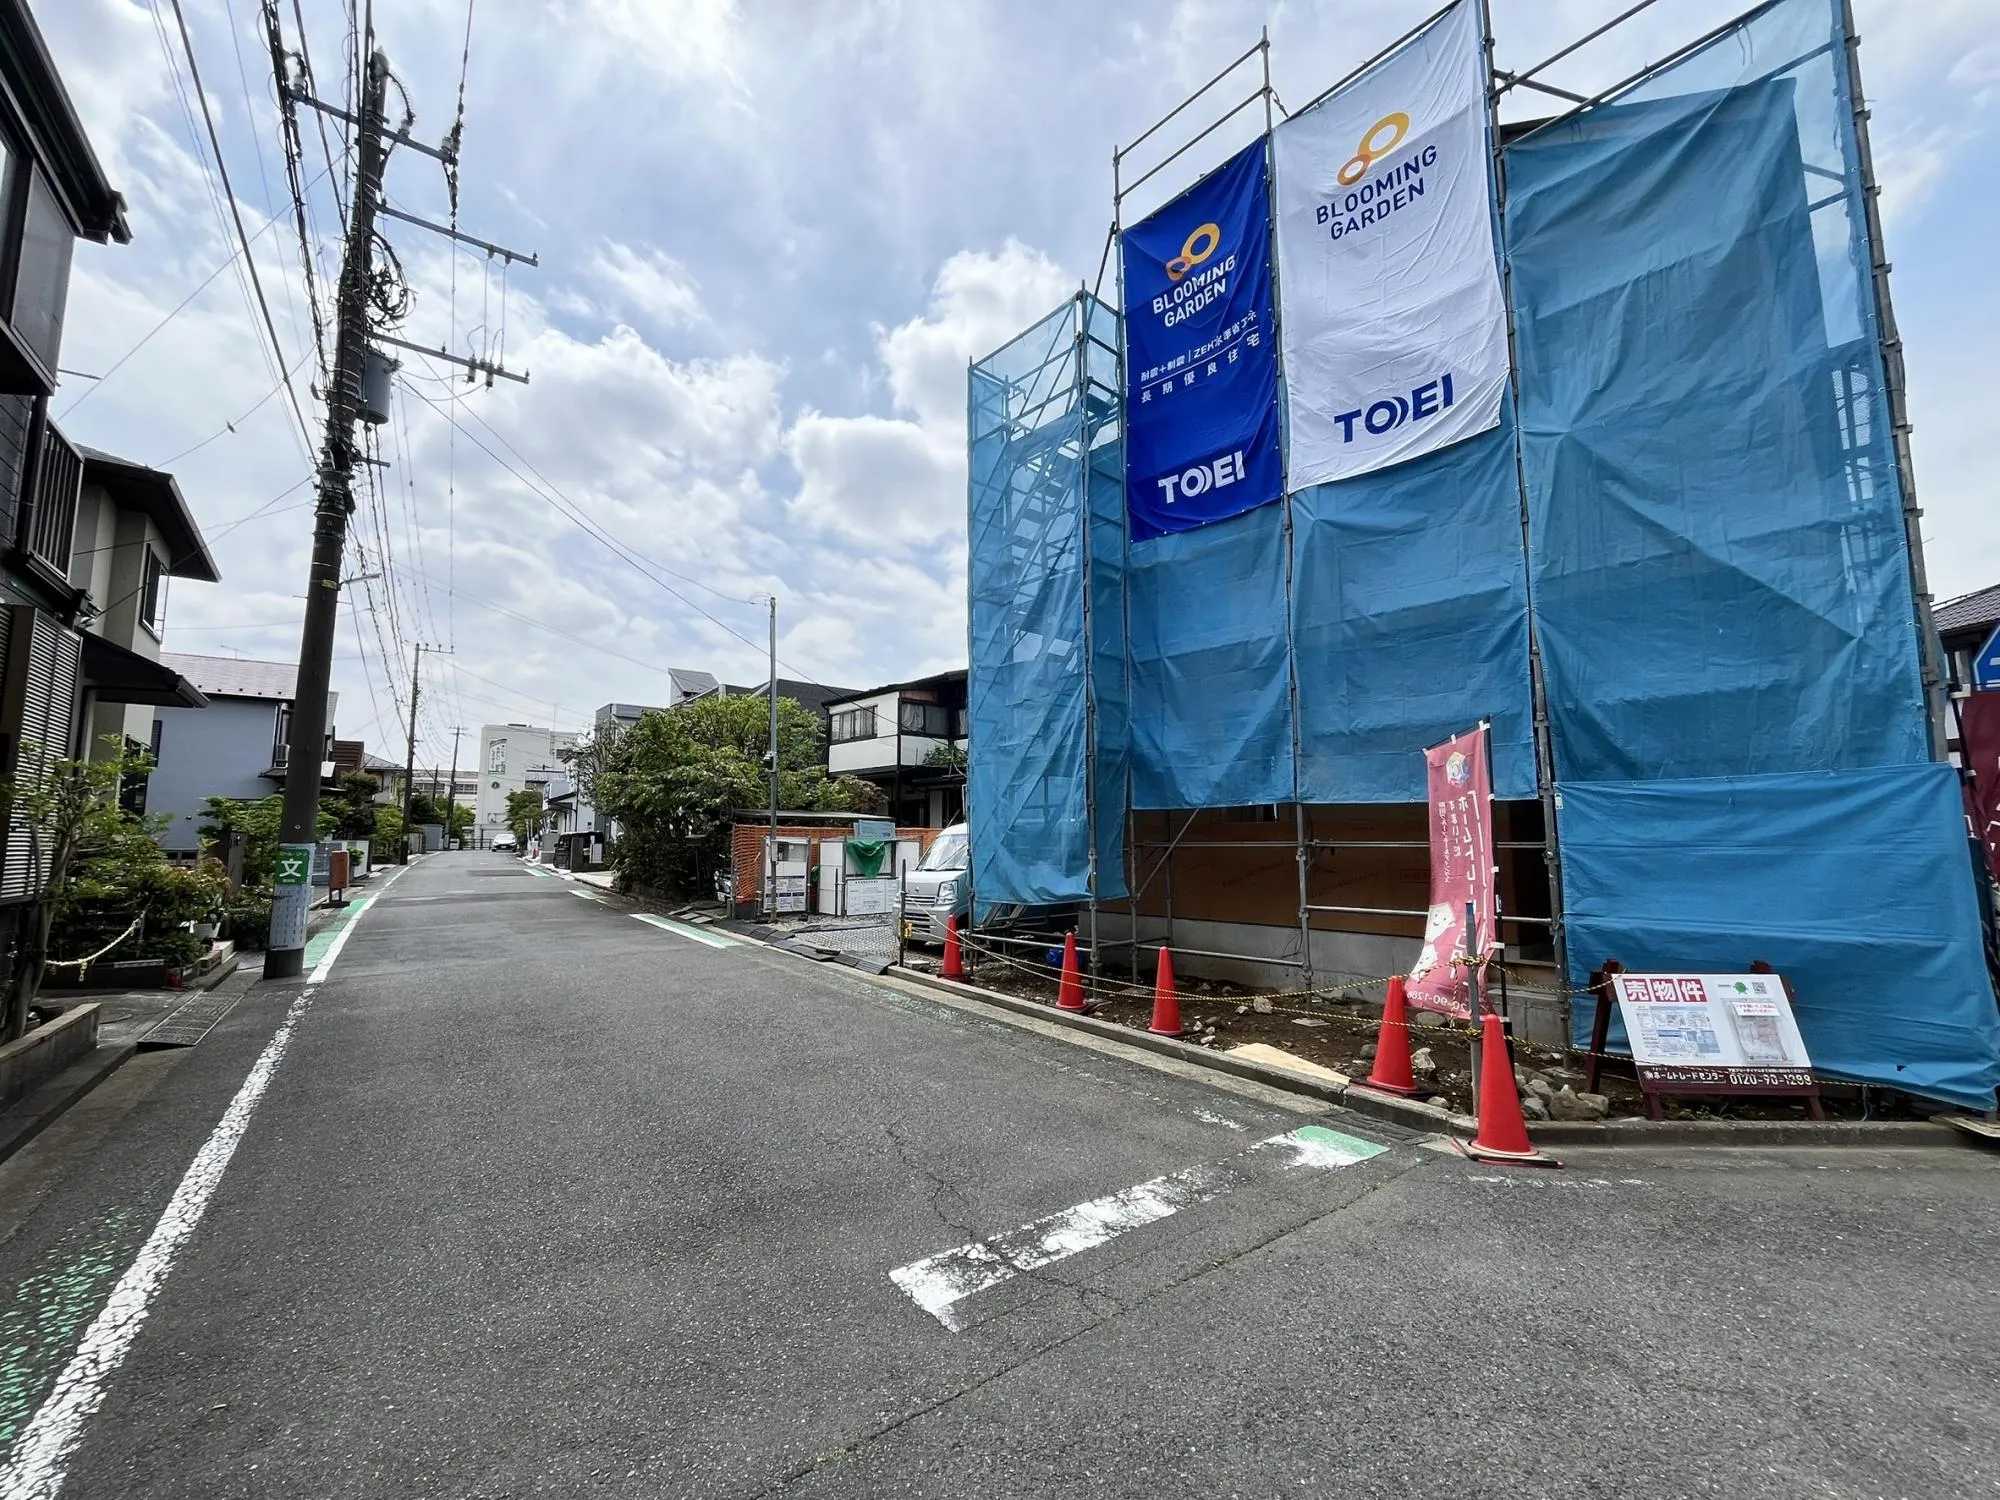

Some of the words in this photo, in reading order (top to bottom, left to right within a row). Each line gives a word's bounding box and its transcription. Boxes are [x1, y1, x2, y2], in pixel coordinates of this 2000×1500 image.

[1316, 145, 1437, 225] BLOOMING
[1330, 177, 1425, 240] GARDEN
[1152, 254, 1236, 315] BLOOMING
[1164, 278, 1226, 328] GARDEN
[279, 858, 303, 877] 文
[1624, 980, 1704, 1001] 売物件
